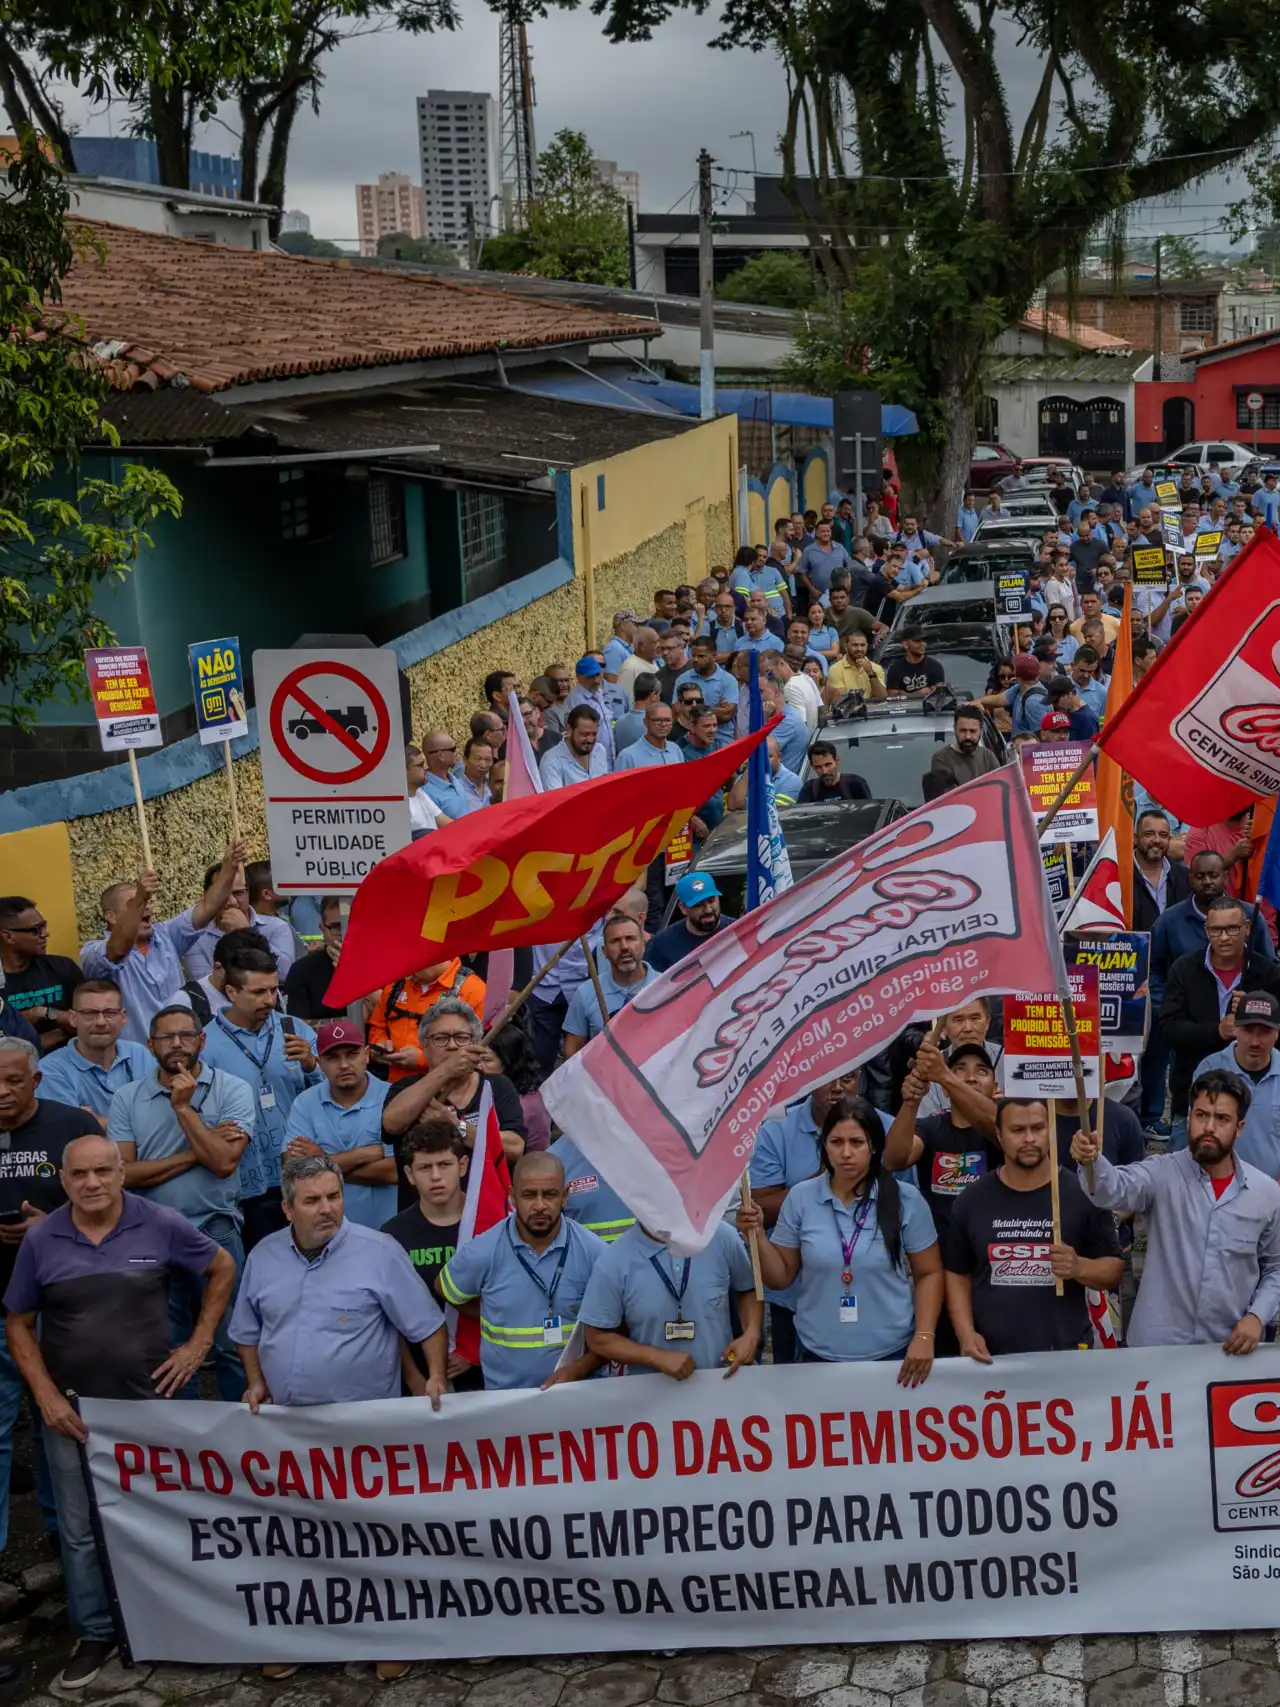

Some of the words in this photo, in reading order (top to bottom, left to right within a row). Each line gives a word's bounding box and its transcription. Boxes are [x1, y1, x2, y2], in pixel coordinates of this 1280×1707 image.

[198, 648, 235, 678] NÃO
[205, 695, 223, 713] gm
[1188, 728, 1249, 775] CENTRAL
[292, 808, 386, 824] PERMITIDO
[296, 834, 386, 850] UTILIDADE
[420, 806, 697, 943] PSTU
[1, 1151, 48, 1164] NEGRAS
[996, 1229, 1043, 1238] construindo
[992, 1245, 1051, 1259] CSP
[994, 1261, 1052, 1277] Conlutas
[114, 1442, 234, 1495] PELO
[240, 1421, 660, 1500] CANCELAMENTO
[673, 1415, 774, 1477] DAS
[787, 1390, 1091, 1469] DEMISSÕES,
[1104, 1380, 1175, 1452] JÁ!
[190, 1515, 483, 1562] ESTABILIDADE
[490, 1516, 553, 1561] NO
[565, 1498, 775, 1559] EMPREGO
[788, 1493, 903, 1546] PARA
[908, 1482, 1053, 1539] TODOS
[1062, 1479, 1119, 1529] OS
[1232, 1564, 1260, 1580] São
[237, 1577, 606, 1627] TRABALHADORES
[613, 1578, 675, 1615] DA
[681, 1564, 877, 1614] GENERAL
[886, 1551, 1080, 1604] MOTORS!
